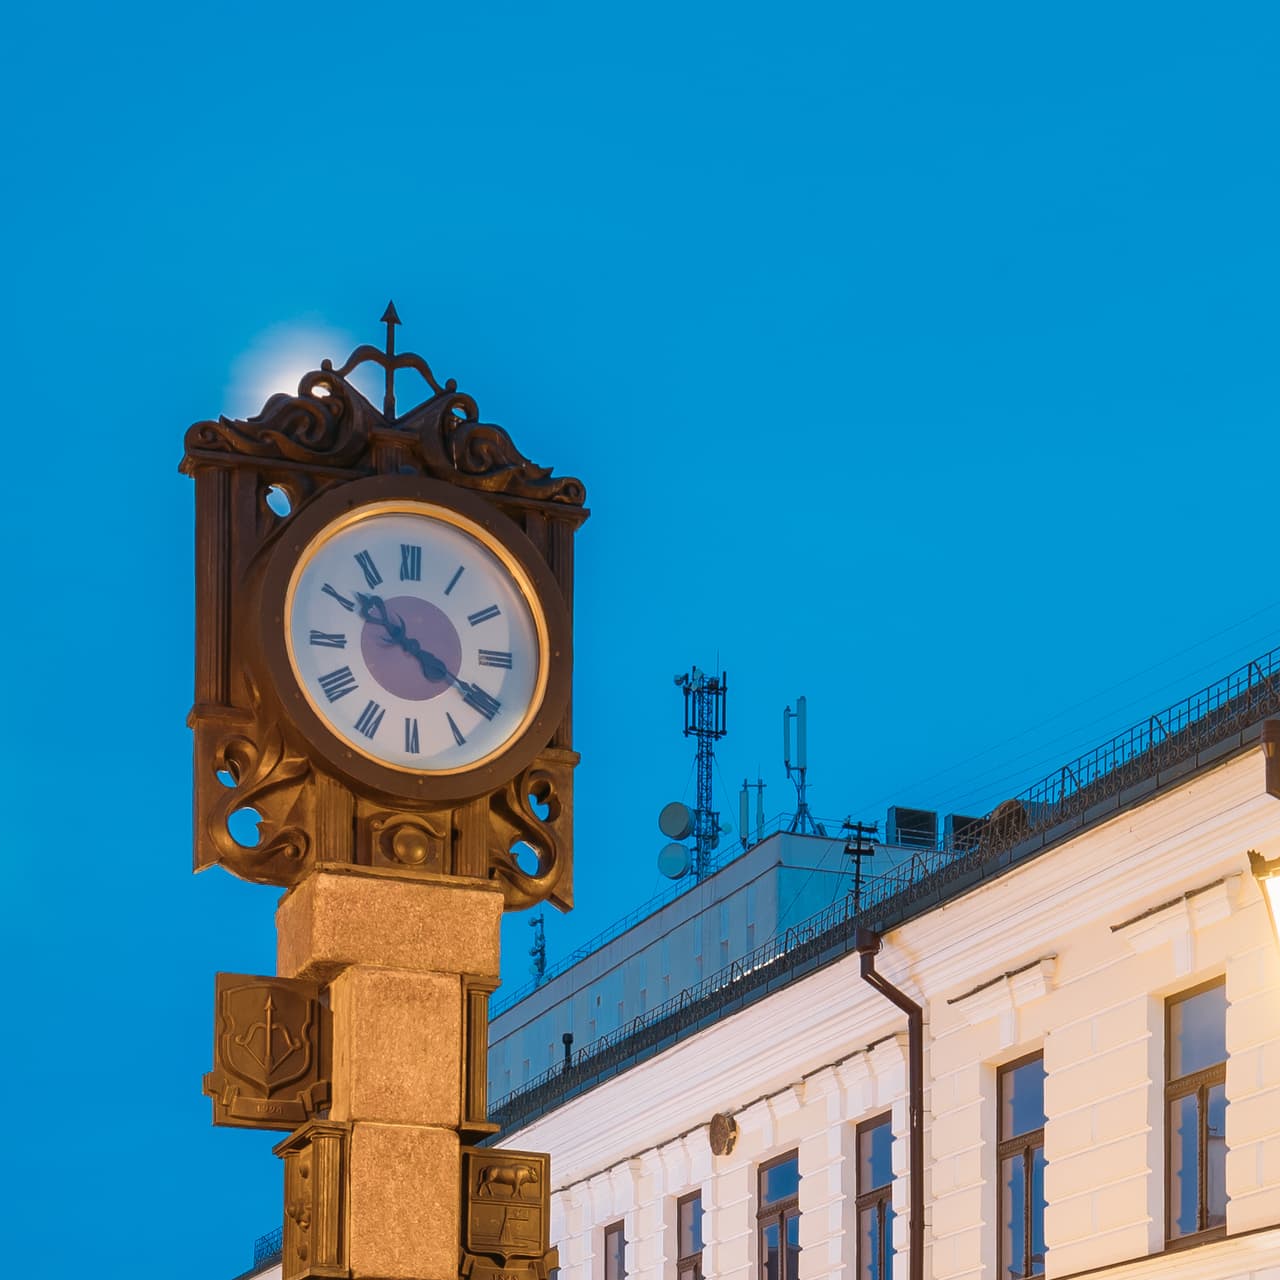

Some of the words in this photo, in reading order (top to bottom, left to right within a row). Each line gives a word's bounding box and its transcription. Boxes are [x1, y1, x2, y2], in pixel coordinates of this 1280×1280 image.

[353, 549, 383, 590] XI
[400, 544, 422, 582] XII
[444, 565, 465, 596] I
[321, 583, 355, 612] X
[468, 604, 501, 627] II
[309, 630, 347, 649] IX
[478, 649, 513, 670] III
[318, 665, 359, 703] VIII
[353, 700, 386, 739] VII
[405, 717, 420, 754] VI
[445, 711, 467, 747] V
